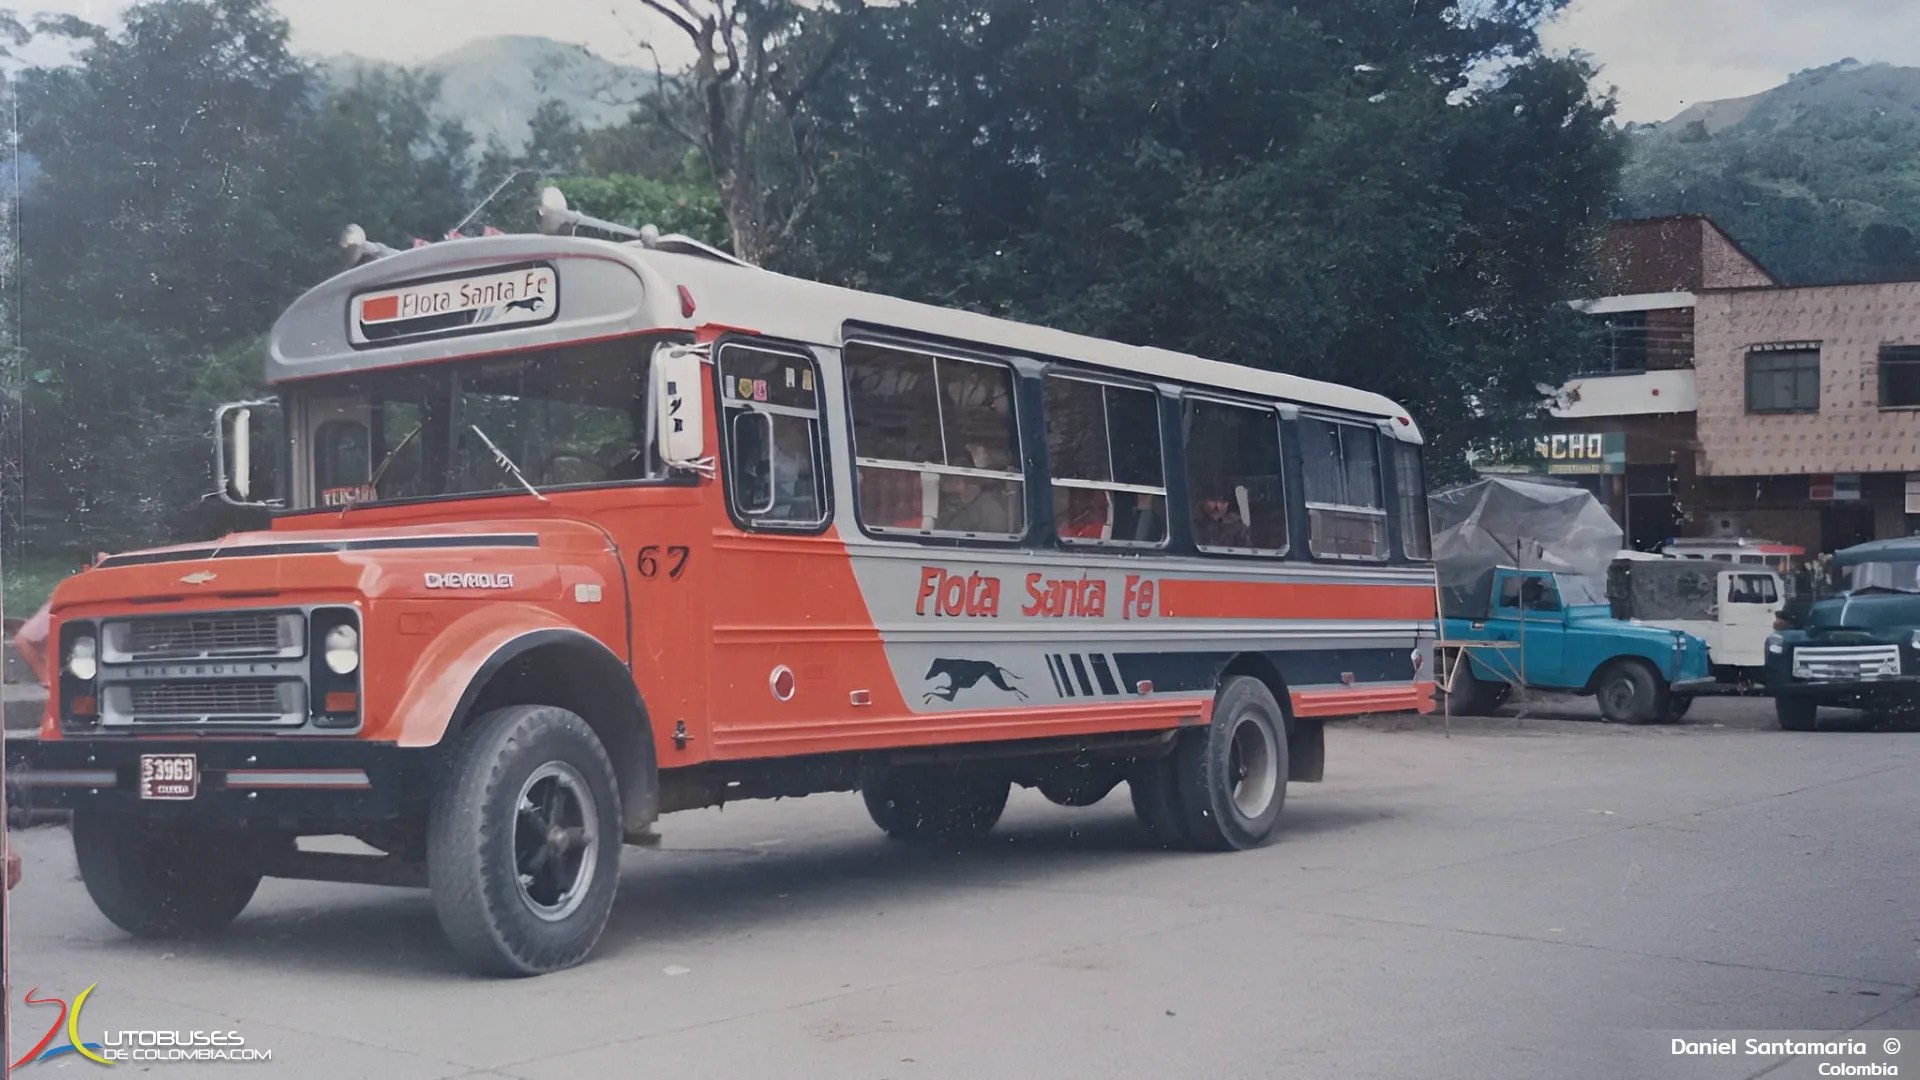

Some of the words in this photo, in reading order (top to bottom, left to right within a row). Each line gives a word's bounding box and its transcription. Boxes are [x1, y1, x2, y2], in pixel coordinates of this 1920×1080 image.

[402, 292, 450, 317] Flota
[460, 281, 515, 307] Santa
[523, 272, 547, 297] Fe
[424, 572, 514, 589] CHEVROLET
[637, 545, 690, 578] 67
[916, 566, 1000, 617] Flota
[1021, 570, 1106, 617] Santa
[1123, 575, 1154, 620] Fe
